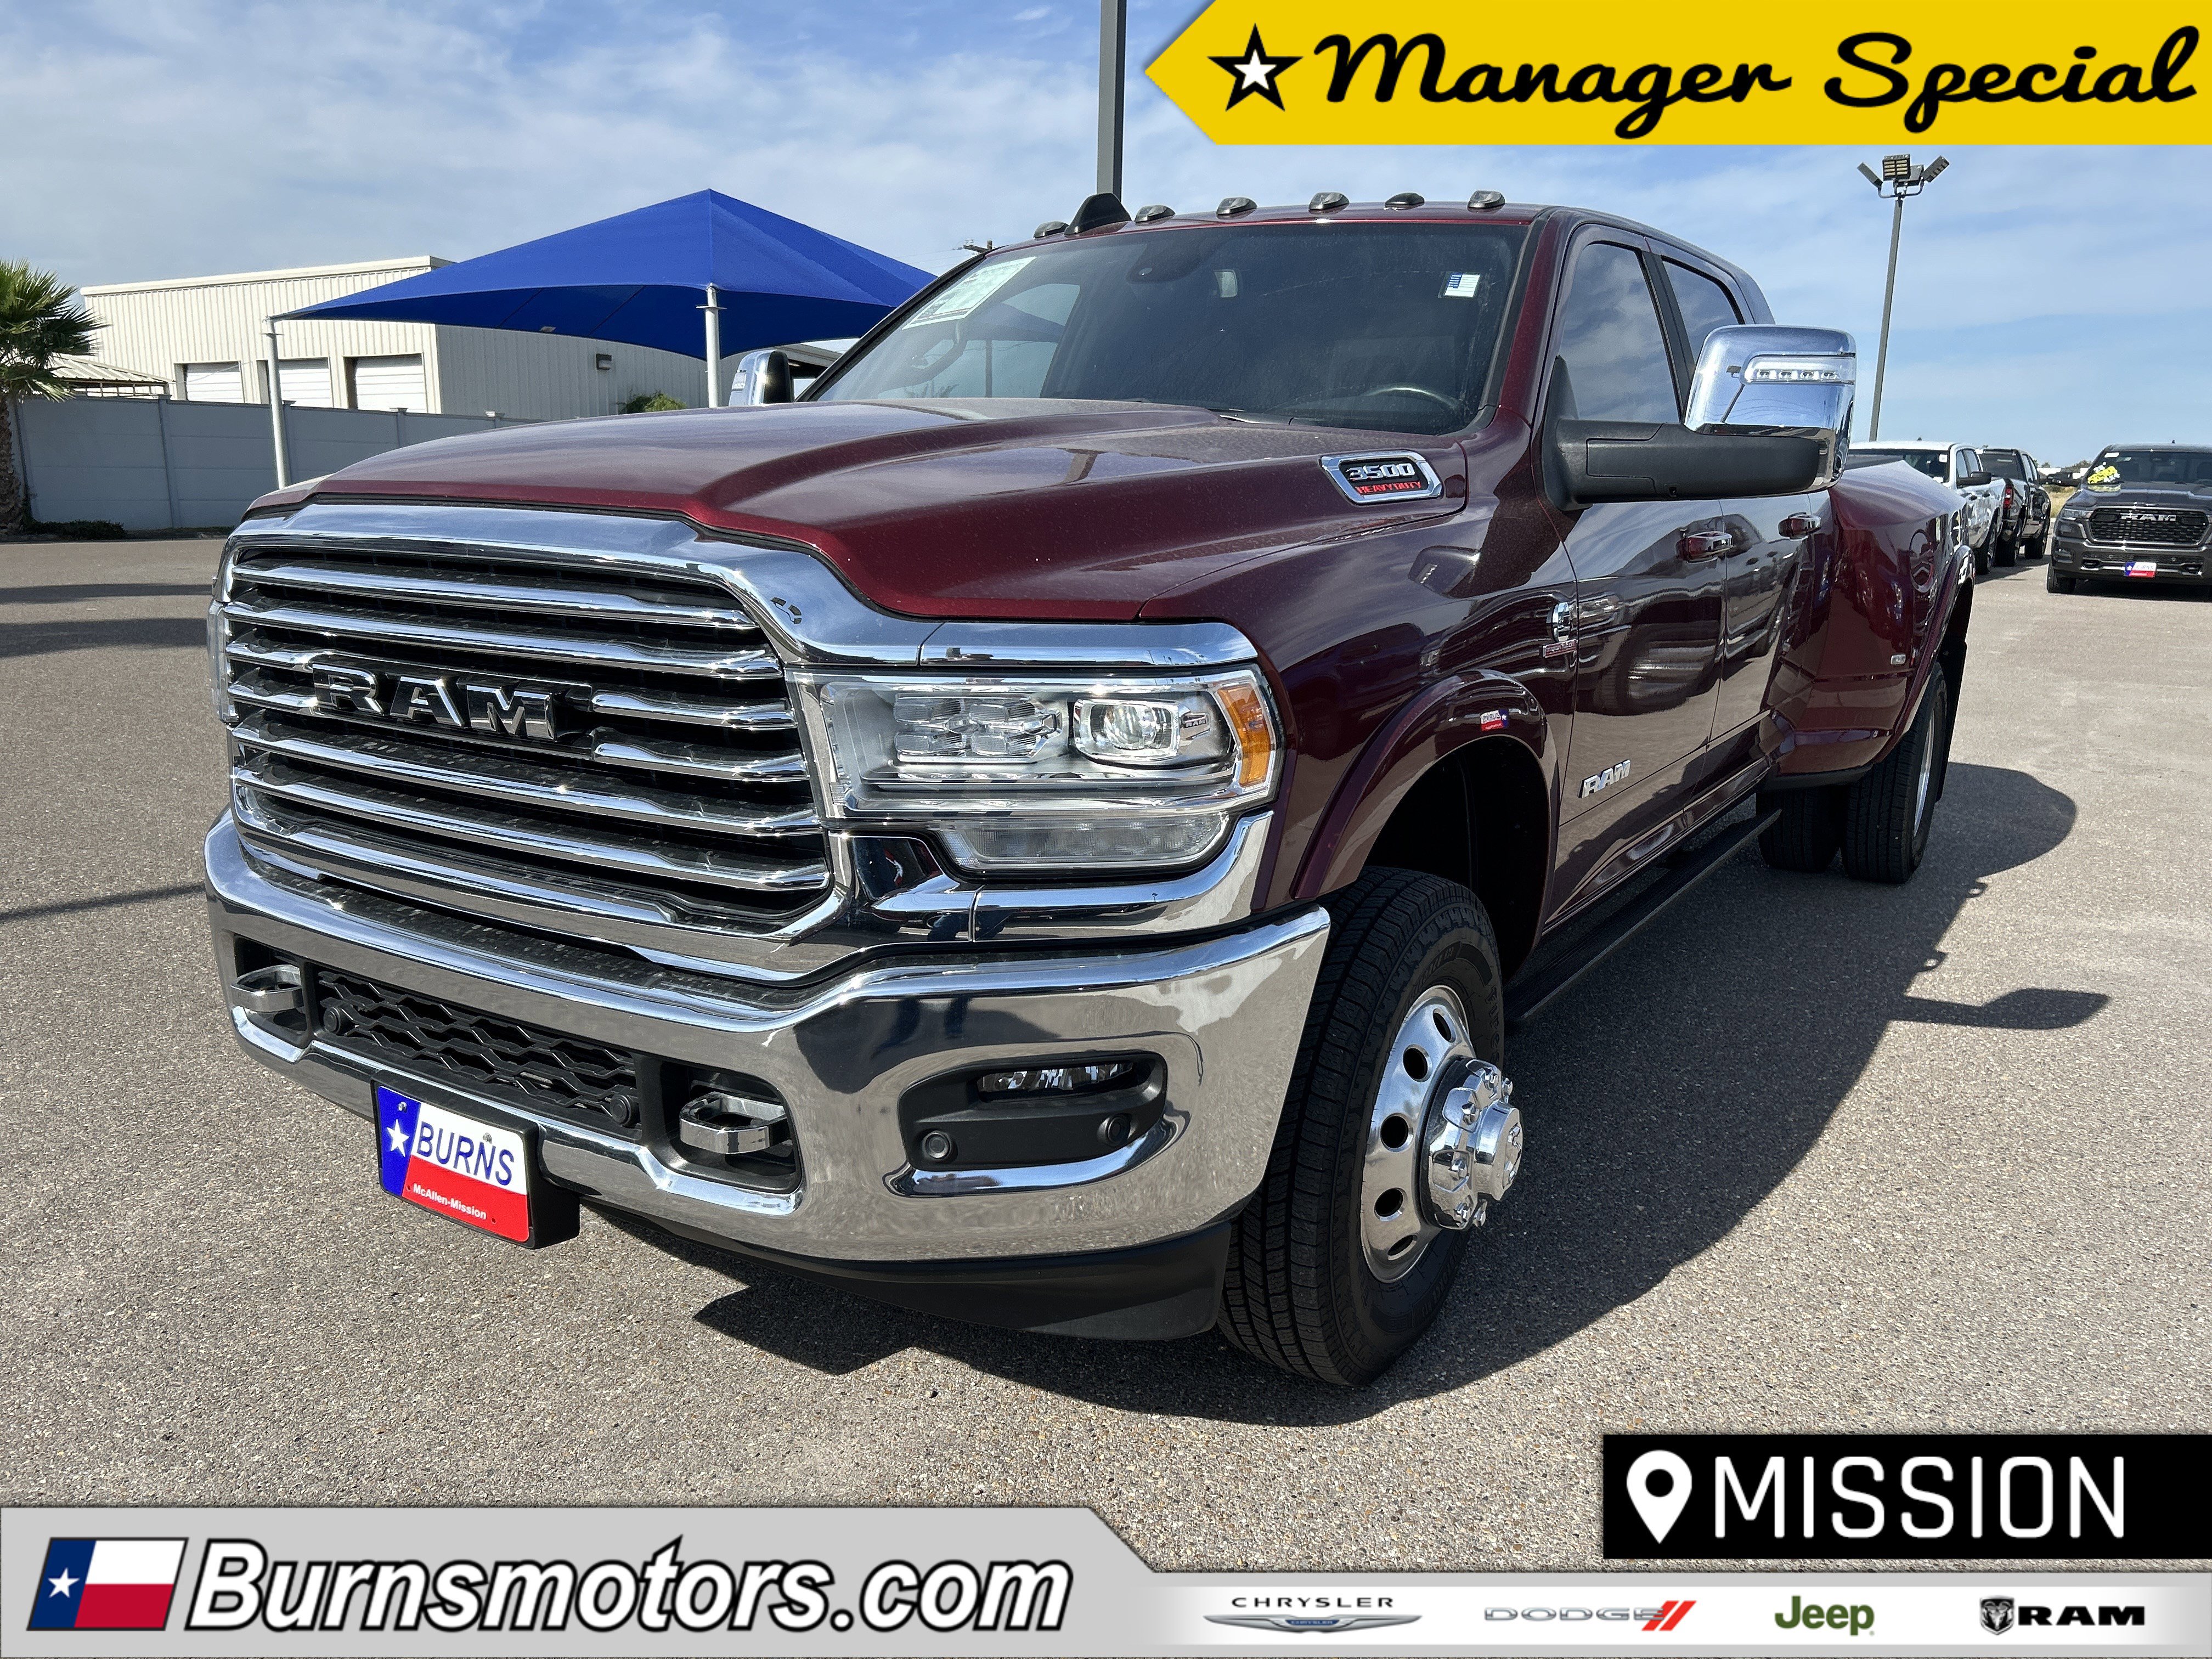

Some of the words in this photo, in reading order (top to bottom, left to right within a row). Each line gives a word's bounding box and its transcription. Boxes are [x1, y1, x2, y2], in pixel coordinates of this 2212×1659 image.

[1346, 463, 1415, 481] 3500
[1355, 483, 1393, 493] HEAVY
[1393, 481, 1421, 490] DUTY
[2120, 512, 2177, 522] RAM
[312, 663, 556, 742] RAM
[1578, 759, 1631, 798] RAM
[417, 1121, 515, 1186] BURNS
[413, 1183, 487, 1220] McAllen-Mission
